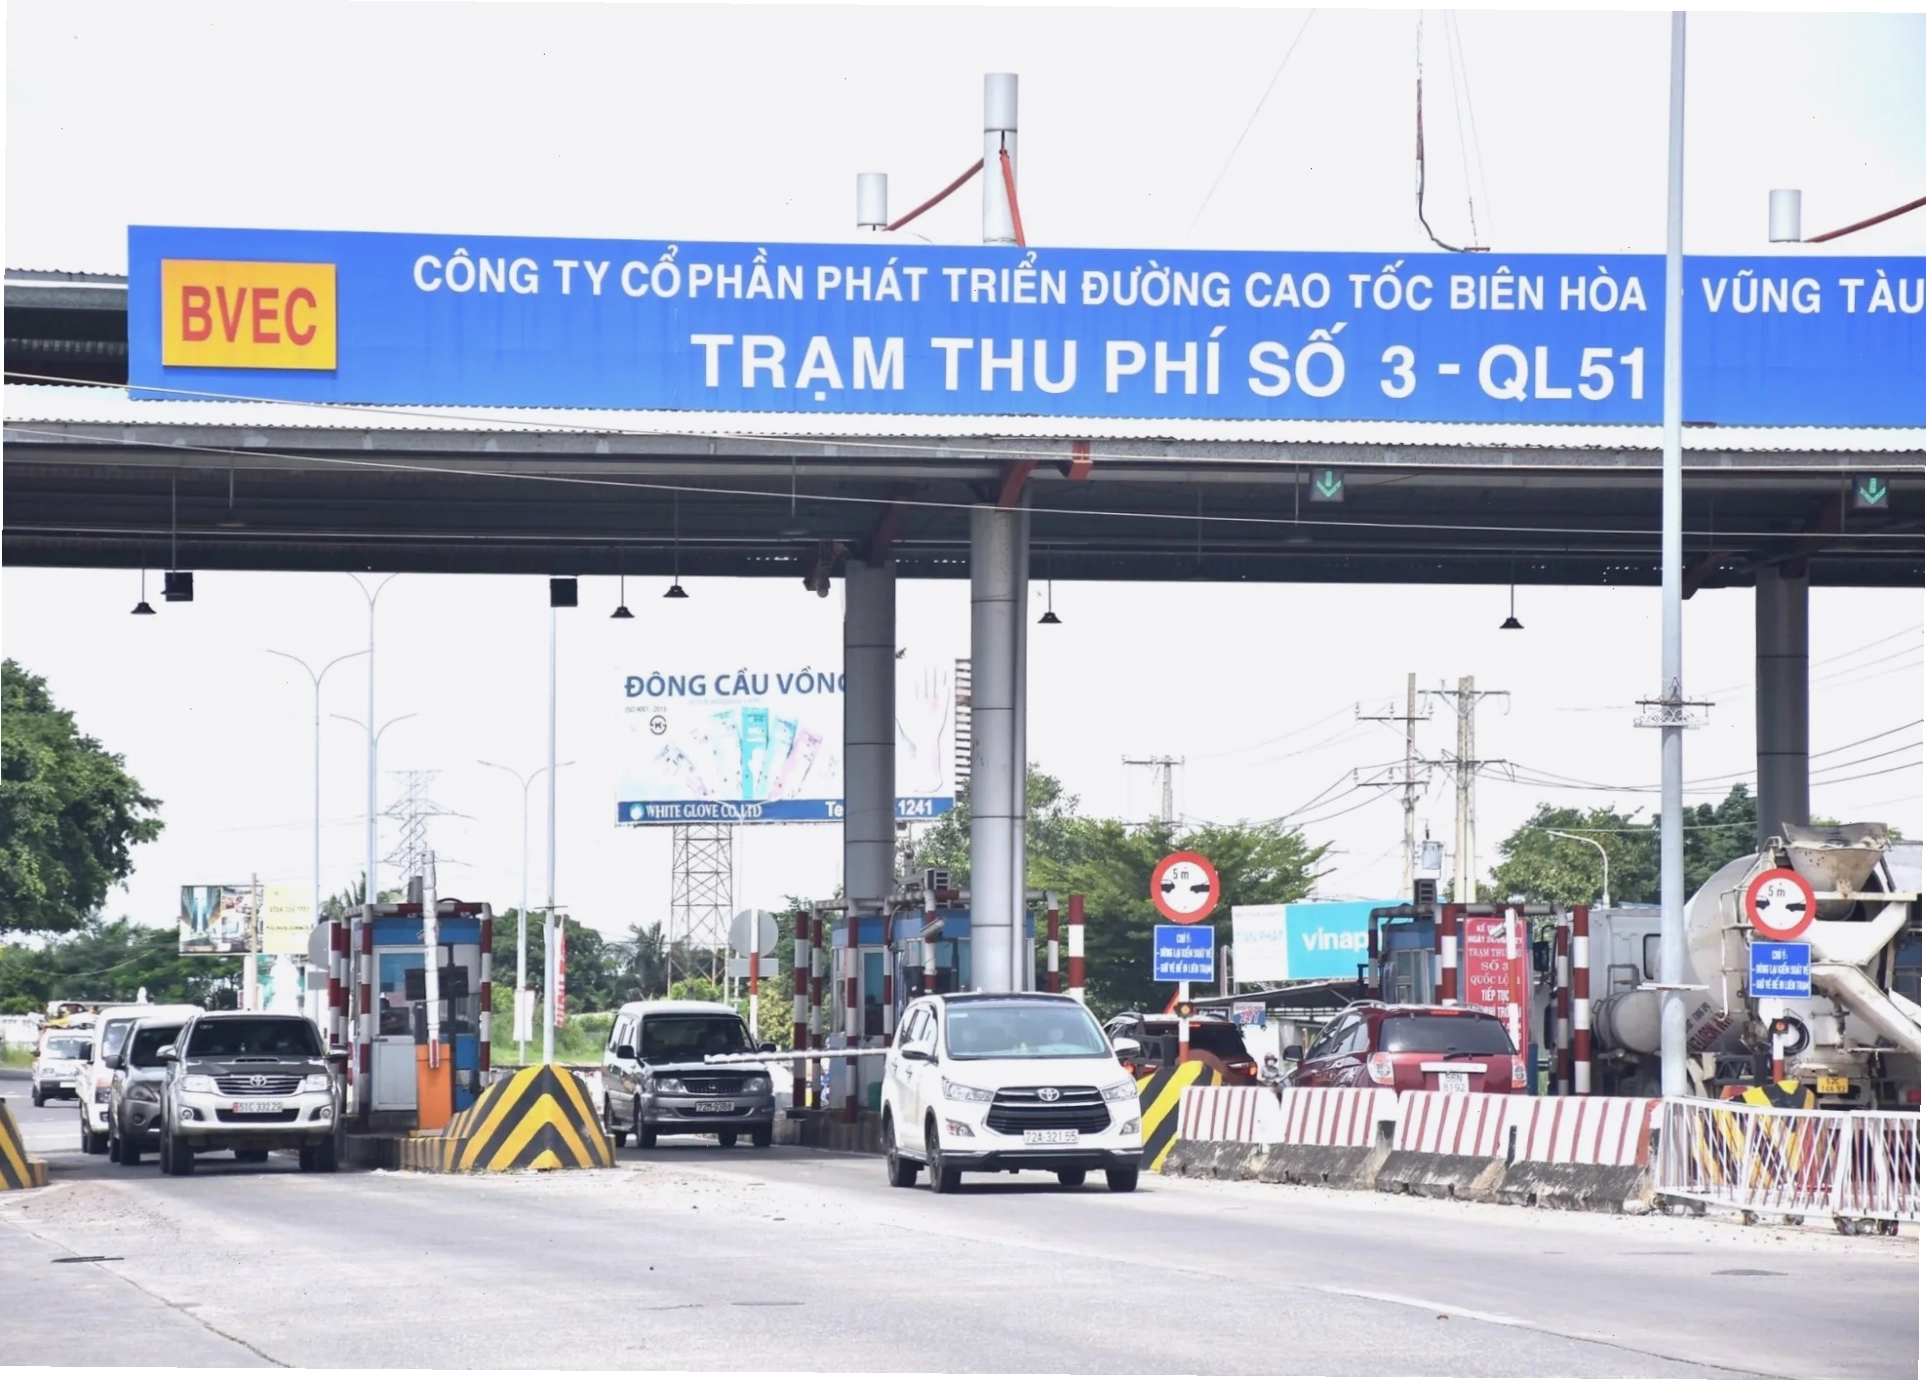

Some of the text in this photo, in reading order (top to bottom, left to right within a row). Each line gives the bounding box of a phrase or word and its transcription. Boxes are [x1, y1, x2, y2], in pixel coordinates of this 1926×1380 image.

[413, 243, 1925, 315] CÔNG TY CỔ PHẦN PHÁT TRIỂN ĐƯỜNG CAO TỐC BIÊN HÒA VŨNG TÀU
[180, 285, 318, 346] BVEC
[690, 333, 905, 402] TRẠM
[930, 337, 1077, 395] THU
[1105, 325, 1220, 397] PHÍ
[1248, 321, 1347, 399] SỐ
[1380, 345, 1416, 400] 3
[1478, 344, 1645, 403] QL51
[624, 671, 707, 698] ĐÔNG
[714, 667, 769, 697] CẦU
[645, 804, 681, 819] WHITE
[683, 804, 719, 818] GLOVE
[898, 799, 933, 815] 1241
[1172, 868, 1190, 880] 5 m
[1767, 885, 1786, 897] 5 m
[1469, 947, 1489, 960] TRẠM
[1480, 959, 1500, 972] SỐ
[1470, 971, 1497, 987] QUỐC
[1481, 986, 1497, 1002] TIẾP
